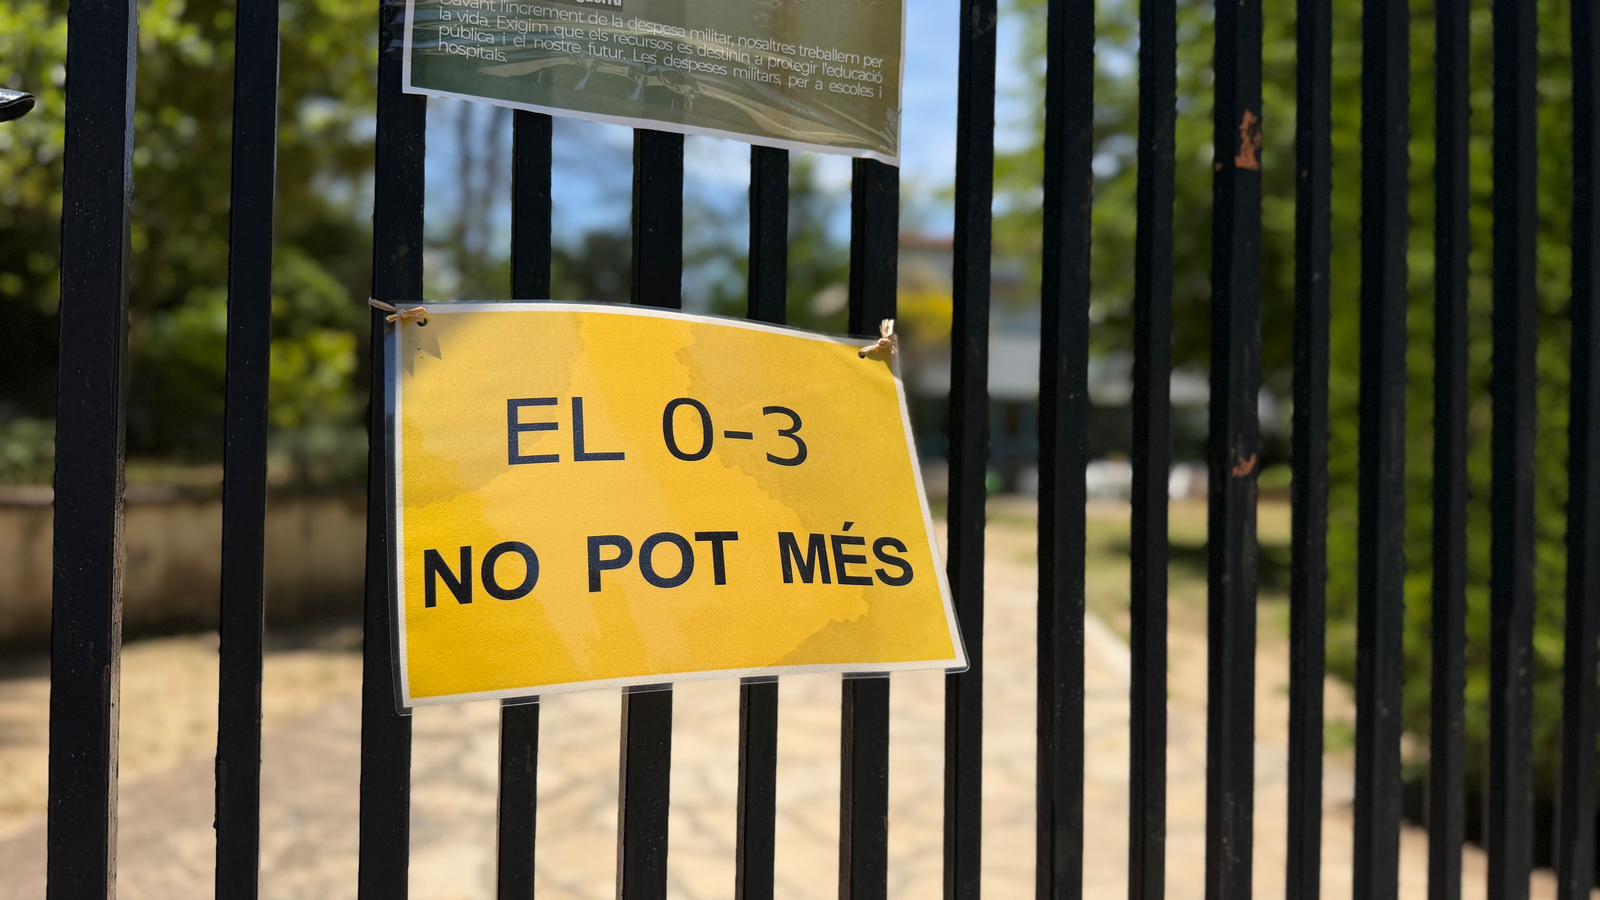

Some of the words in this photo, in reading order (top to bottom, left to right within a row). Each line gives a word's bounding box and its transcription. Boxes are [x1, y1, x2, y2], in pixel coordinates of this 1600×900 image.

[438, 39, 508, 62] hospitals.
[439, 7, 452, 20] la
[457, 10, 491, 27] vida.
[497, 16, 549, 34] Exigim
[553, 25, 584, 38] que
[588, 28, 609, 41] els
[613, 33, 673, 51] recursos
[677, 43, 693, 54] es
[697, 44, 750, 64] destinin
[754, 55, 763, 66] a
[767, 56, 818, 76] protegir
[822, 62, 883, 84] l'educació
[500, 0, 585, 24] l'increment
[588, 11, 608, 25] de
[612, 14, 624, 28] la
[627, 17, 685, 38] despesa
[690, 28, 734, 47] militar,
[738, 37, 796, 55] nosaltres
[800, 44, 860, 65] treballem
[863, 56, 884, 69] per
[513, 35, 526, 47] el
[534, 39, 581, 53] nostre
[588, 42, 626, 60] futur.
[633, 49, 657, 64] Les
[663, 54, 727, 76] despeses
[788, 76, 809, 88] per
[814, 80, 823, 90] a
[828, 81, 874, 97] escoles
[508, 397, 625, 465] EL
[663, 398, 807, 466] 0-3
[424, 542, 539, 608] NO
[588, 532, 738, 592] POT
[778, 522, 913, 586] MÉS
